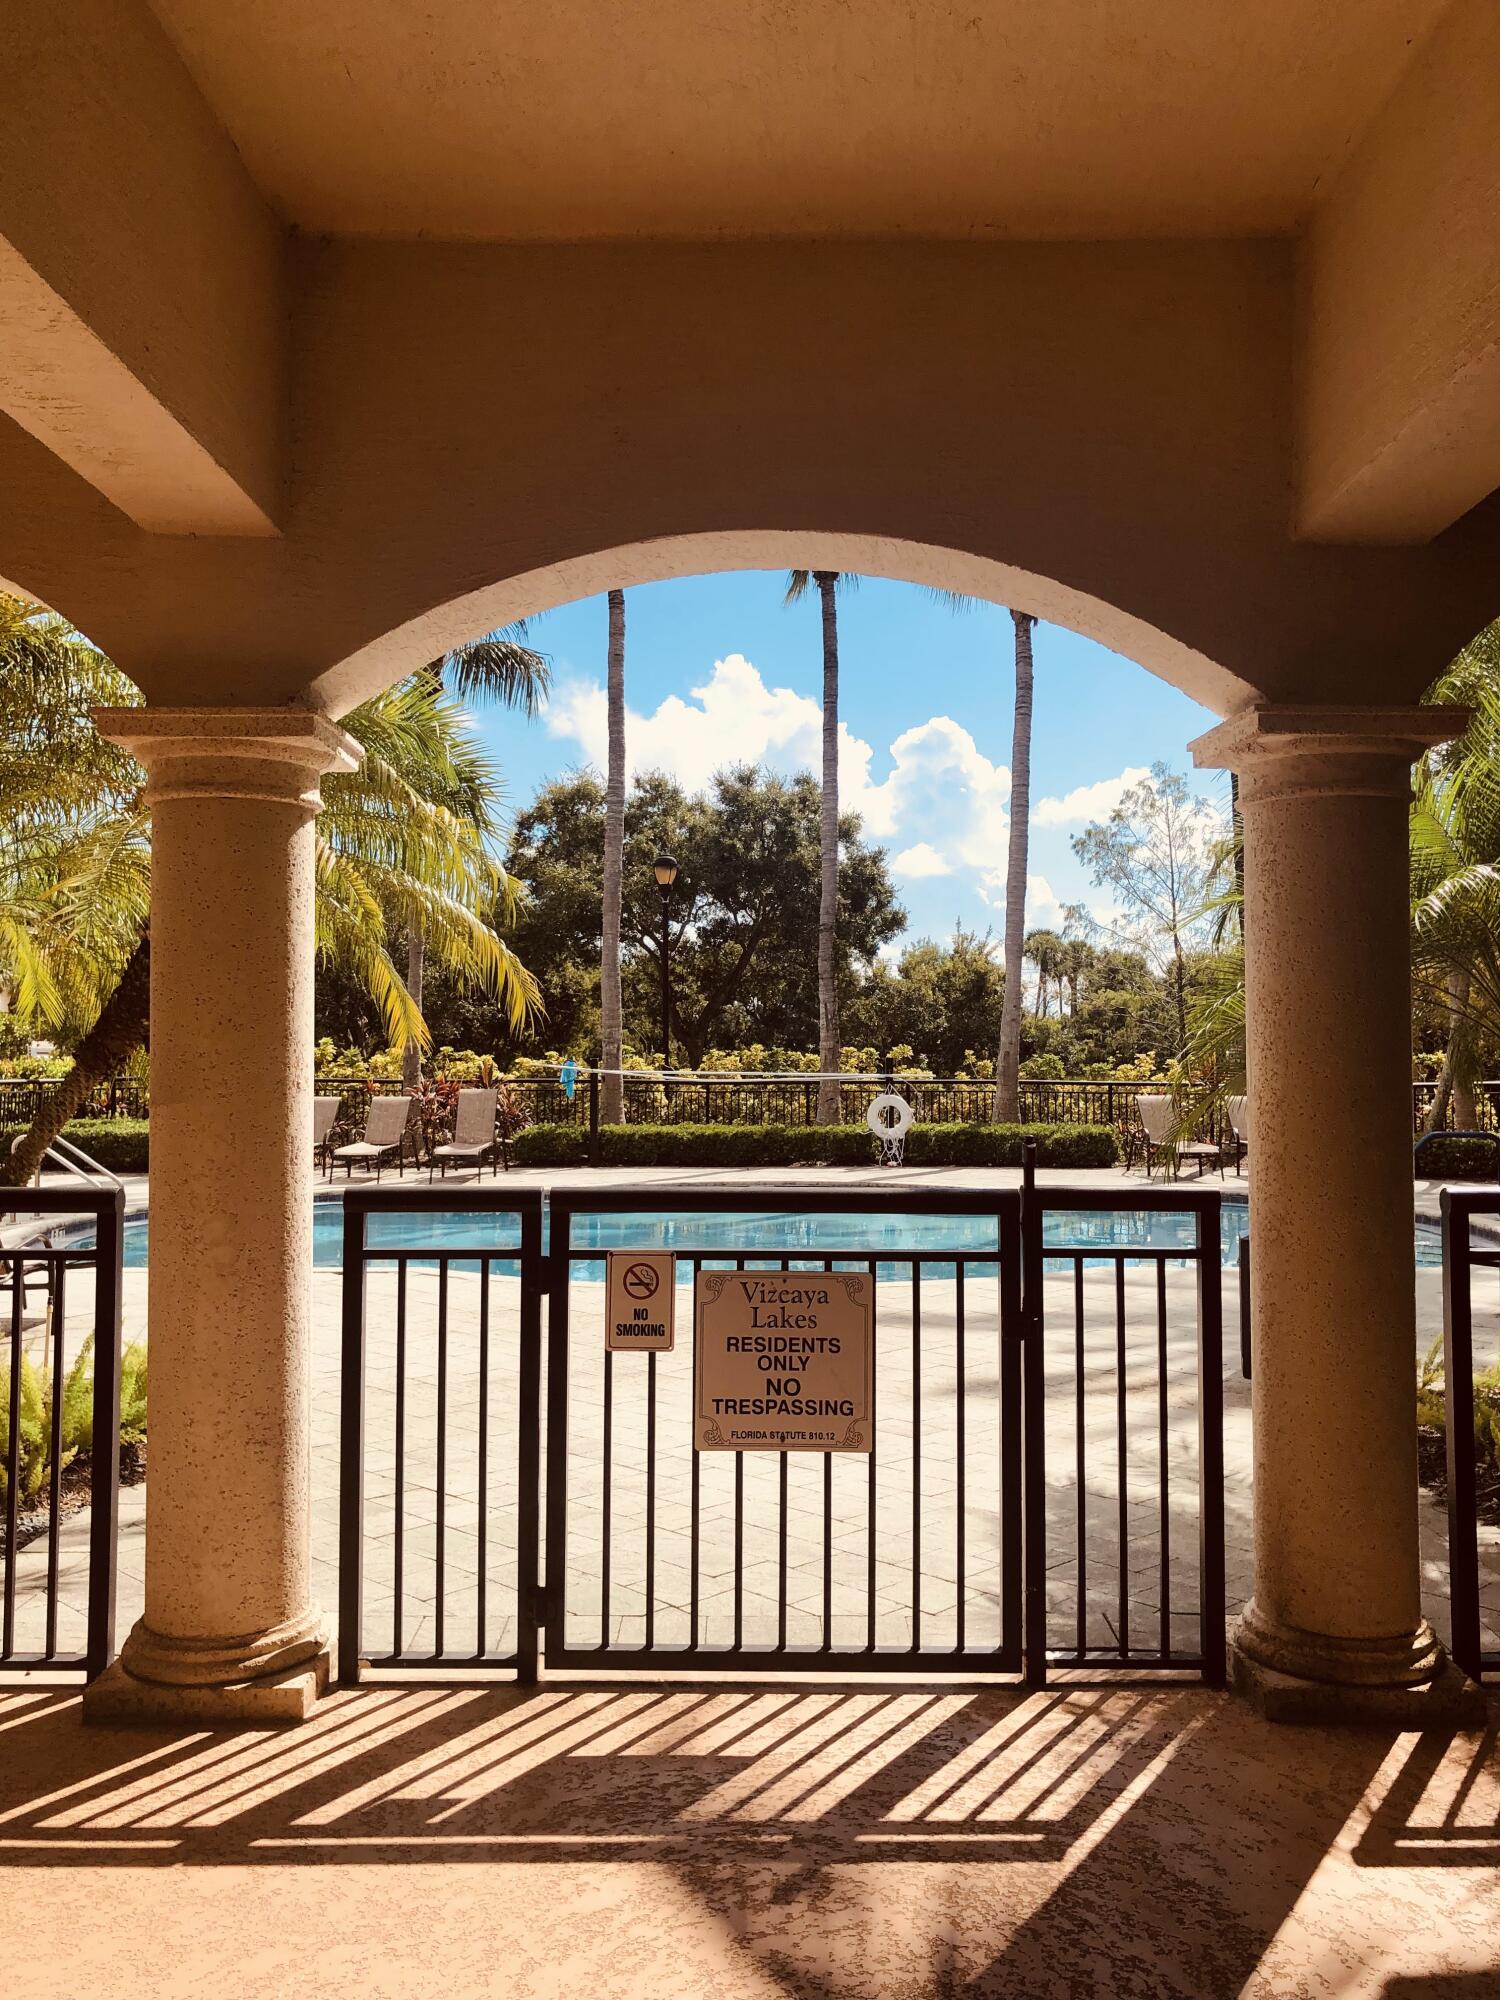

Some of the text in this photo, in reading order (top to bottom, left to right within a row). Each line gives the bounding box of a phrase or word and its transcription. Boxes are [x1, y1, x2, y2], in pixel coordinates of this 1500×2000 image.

[740, 1281, 829, 1309] Vizcaya
[633, 1308, 648, 1321] NO
[750, 1307, 817, 1329] Lakes
[616, 1324, 665, 1337] SMOKING
[726, 1337, 841, 1354] RESIDENTS
[757, 1356, 810, 1371] ONLY
[766, 1378, 801, 1396] NO
[712, 1399, 854, 1416] TRESPASSING
[731, 1431, 835, 1441] FLORIDA STATUTE 810.12
